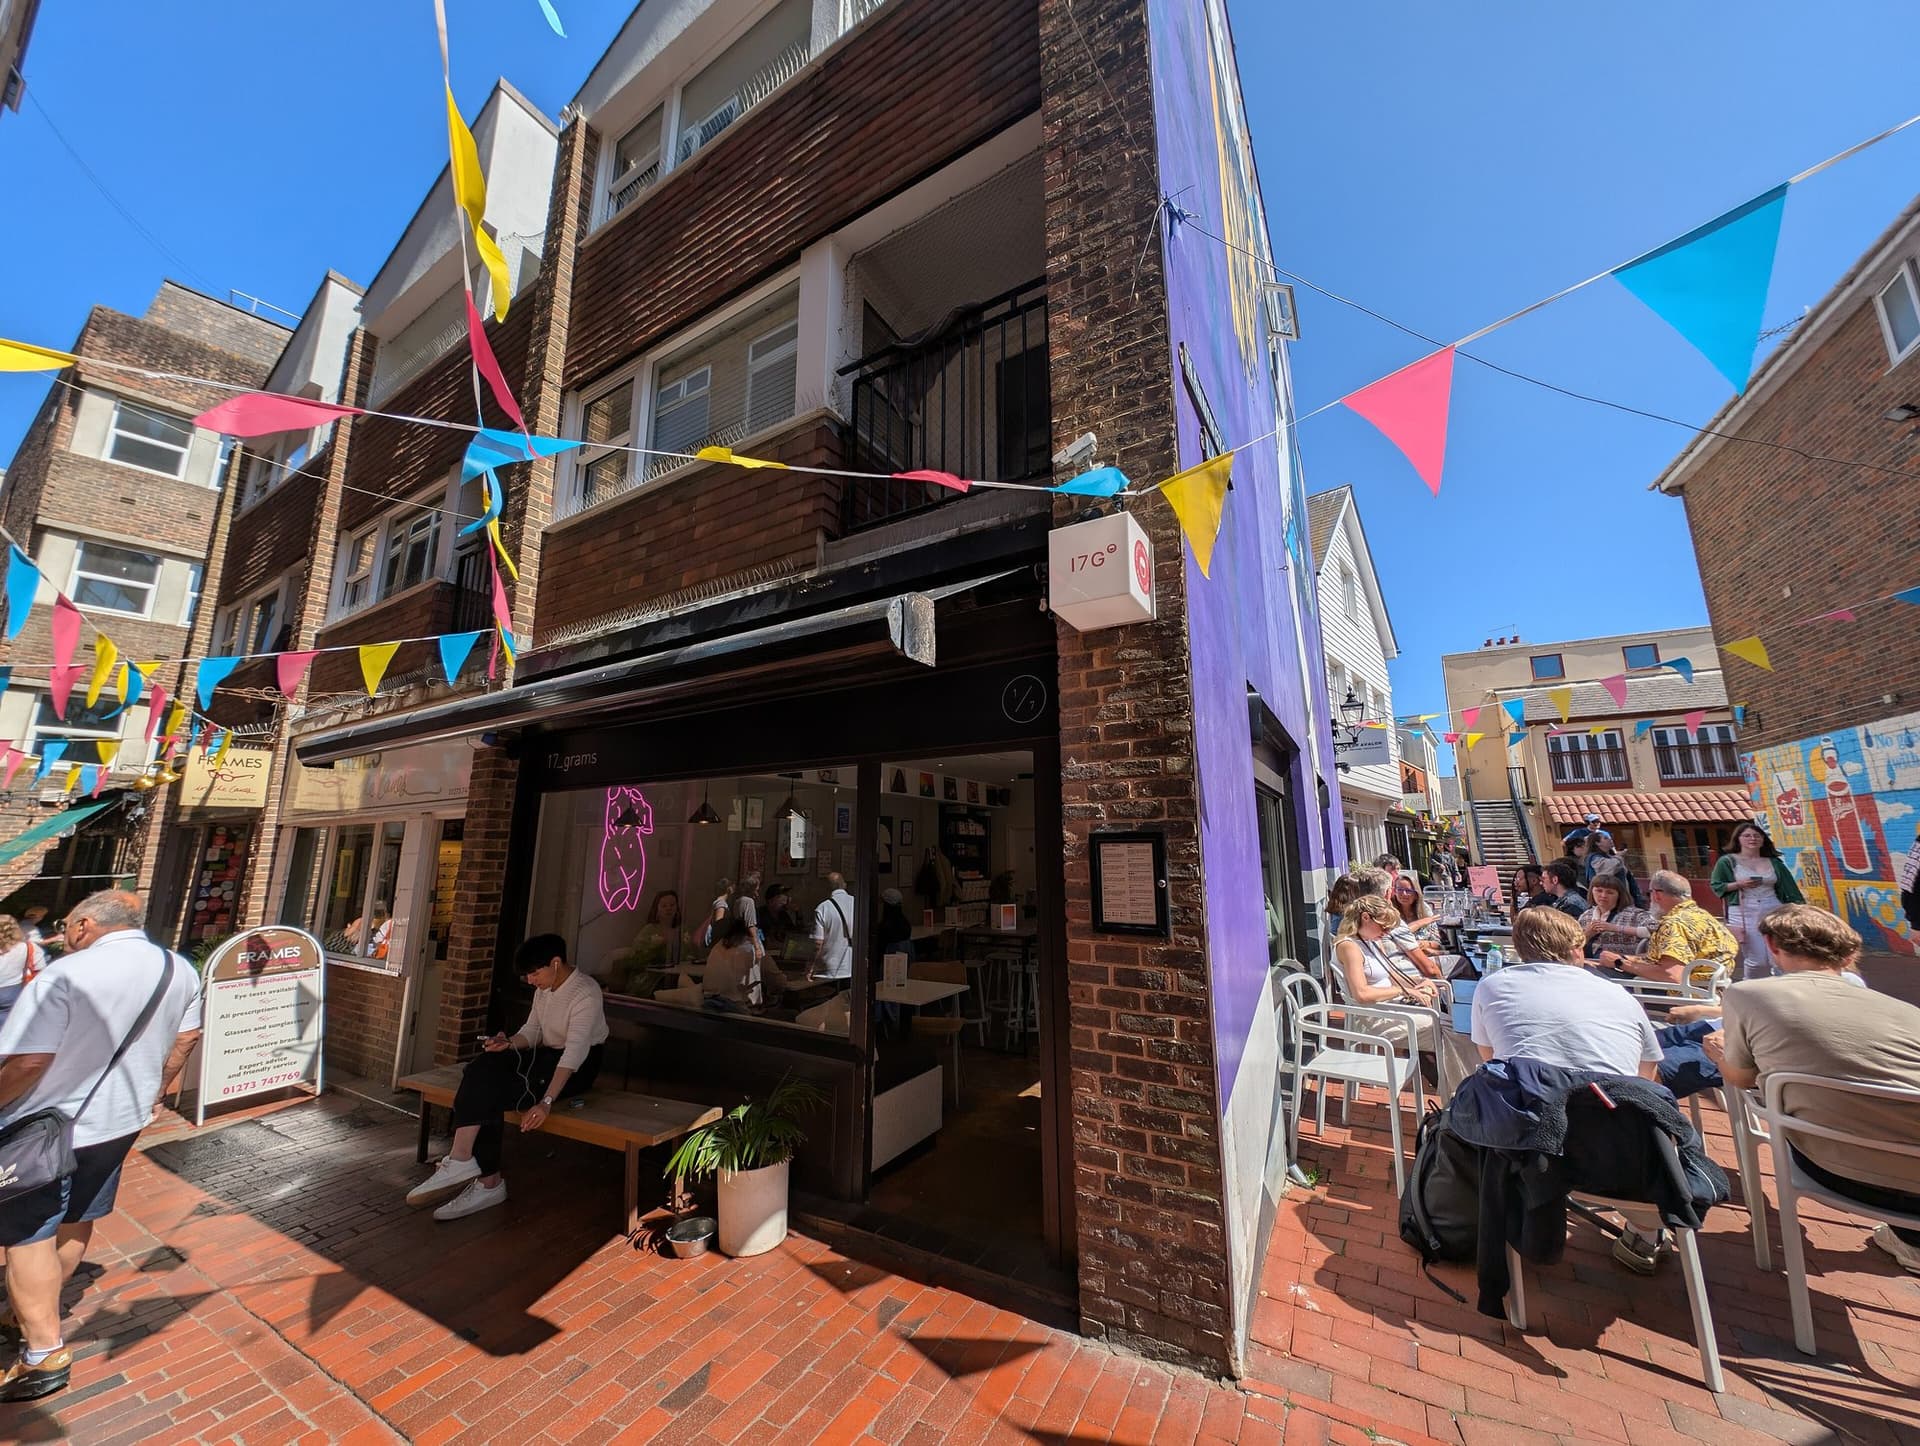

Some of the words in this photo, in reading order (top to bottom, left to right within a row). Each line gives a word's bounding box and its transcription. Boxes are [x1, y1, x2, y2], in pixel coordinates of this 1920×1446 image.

[198, 755, 262, 769] FRAMES
[237, 946, 301, 964] FRAMES
[219, 1012, 231, 1020] All
[232, 1006, 279, 1019] prescriptions
[224, 1028, 252, 1037] Glasses
[253, 1024, 267, 1032] and
[223, 1047, 243, 1056] Many
[245, 1041, 278, 1051] exclusive
[226, 1072, 241, 1080] and
[243, 1065, 271, 1077] friendly
[272, 1060, 298, 1070] service
[238, 1061, 264, 1071] Expert
[265, 1055, 288, 1065] advice
[222, 1081, 257, 1096] 01273
[261, 1070, 301, 1087] 747769
